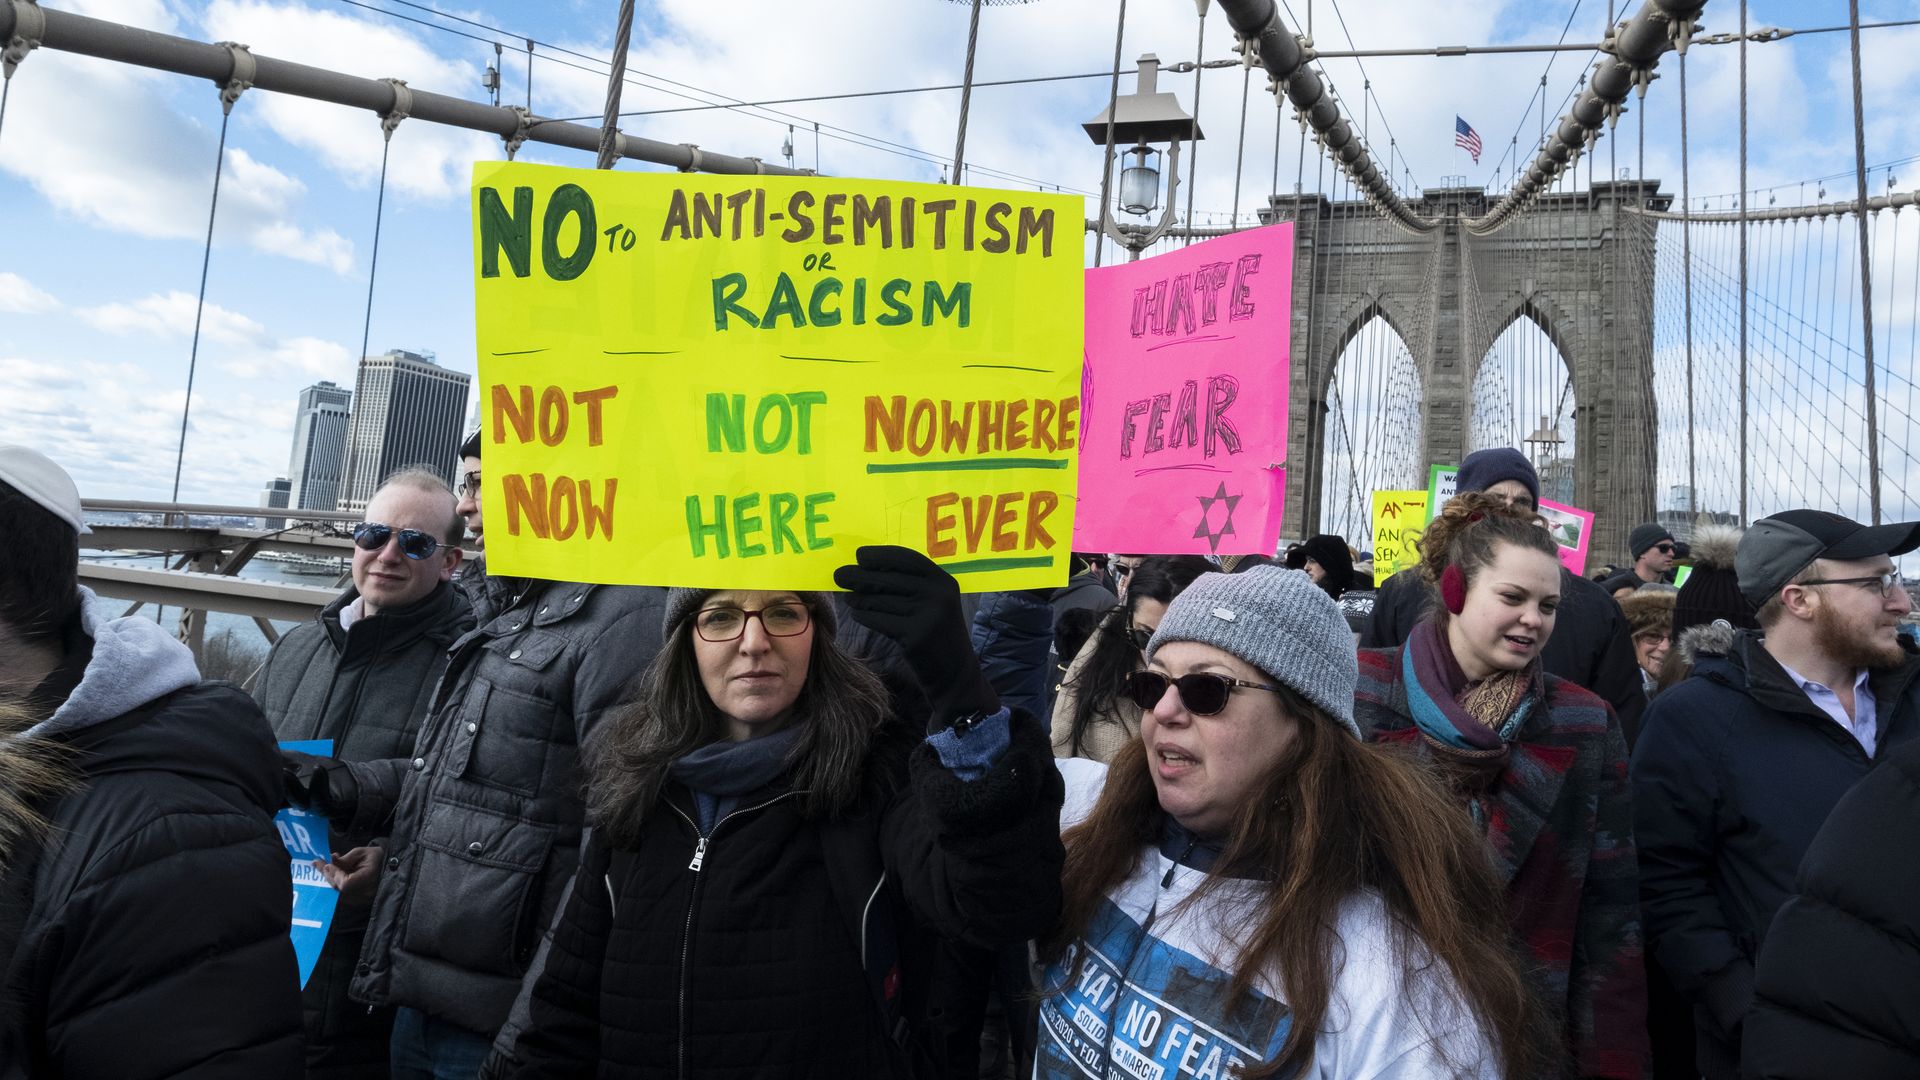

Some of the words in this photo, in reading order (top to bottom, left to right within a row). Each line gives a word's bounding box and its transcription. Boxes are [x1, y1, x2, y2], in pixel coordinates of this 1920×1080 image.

[480, 184, 597, 281] NO
[604, 223, 636, 253] TO
[660, 189, 1055, 258] ANTI-SEMITISM
[803, 252, 836, 272] OR
[712, 272, 972, 332] RACISM
[1130, 253, 1262, 338] HATE
[491, 384, 618, 447] NOT
[706, 391, 827, 455] NOT
[863, 395, 1079, 457] NOWHERE
[1120, 373, 1243, 460] FEAR
[502, 472, 618, 542] NOW
[686, 491, 835, 559] HERE
[926, 490, 1058, 559] EVER
[1121, 999, 1161, 1048] NO
[1121, 1049, 1158, 1080] MARCH
